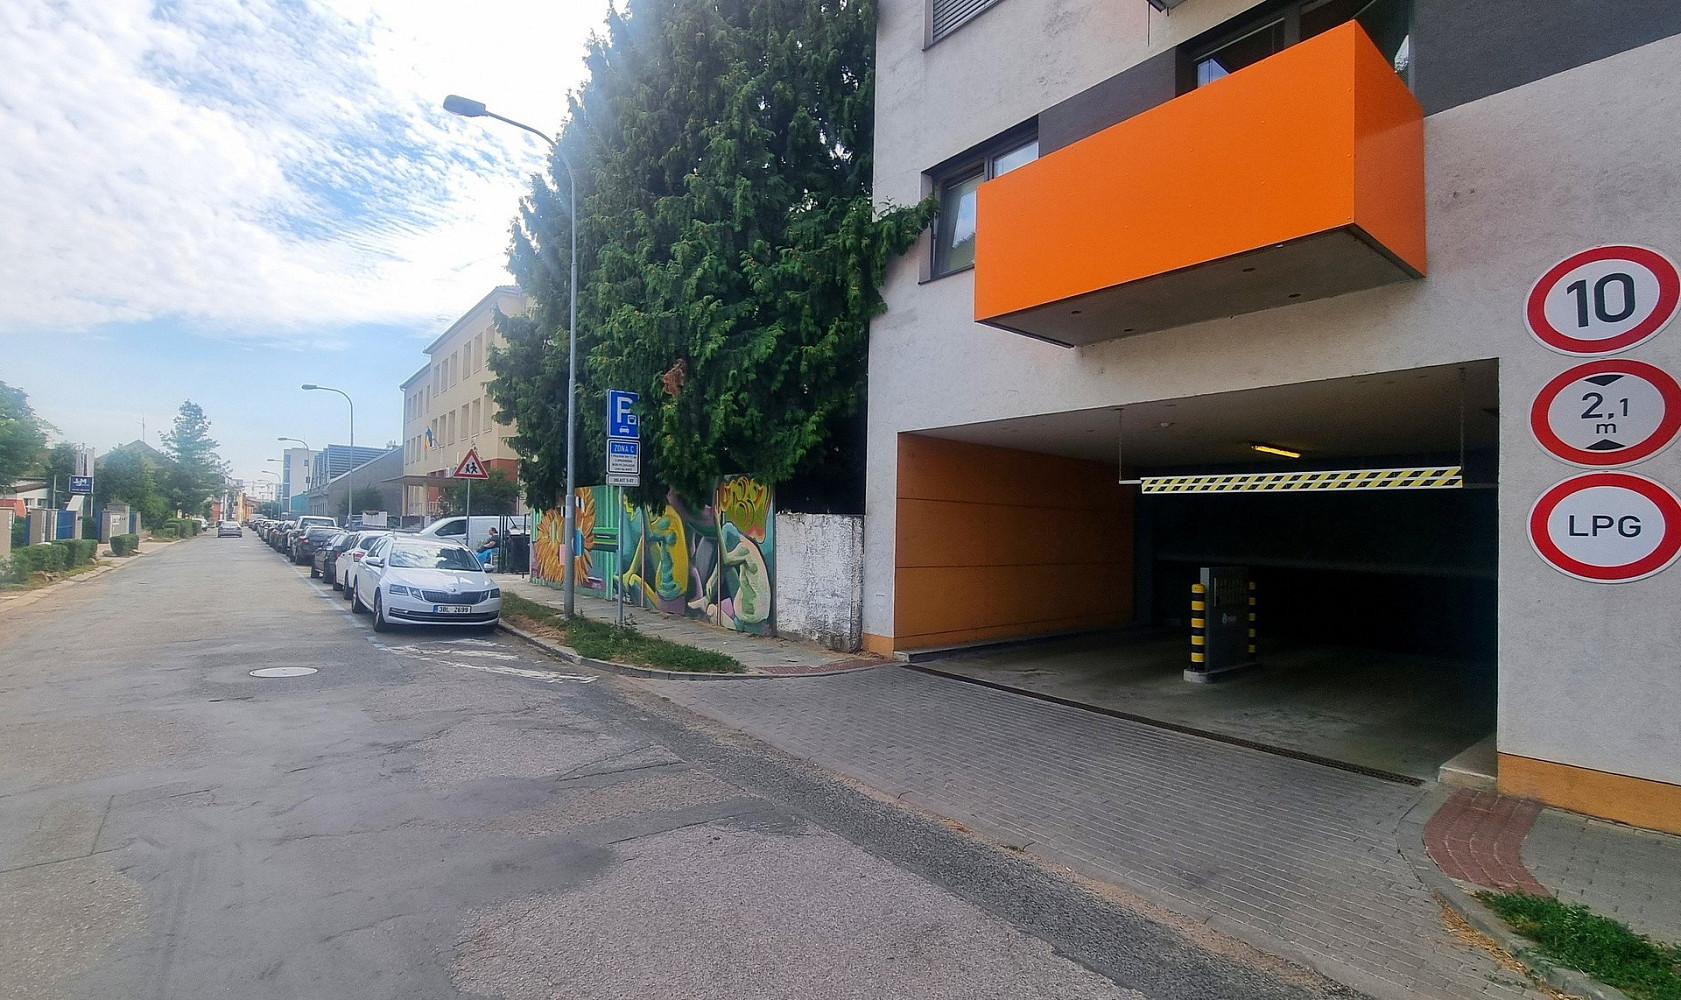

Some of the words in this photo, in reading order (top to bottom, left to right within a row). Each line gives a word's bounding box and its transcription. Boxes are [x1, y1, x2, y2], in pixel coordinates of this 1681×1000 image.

[1566, 272, 1636, 328] 10
[616, 396, 633, 423] P
[1581, 392, 1629, 420] 2,1
[1596, 422, 1617, 434] m
[614, 444, 629, 452] ZONA
[1569, 514, 1642, 538] LPG
